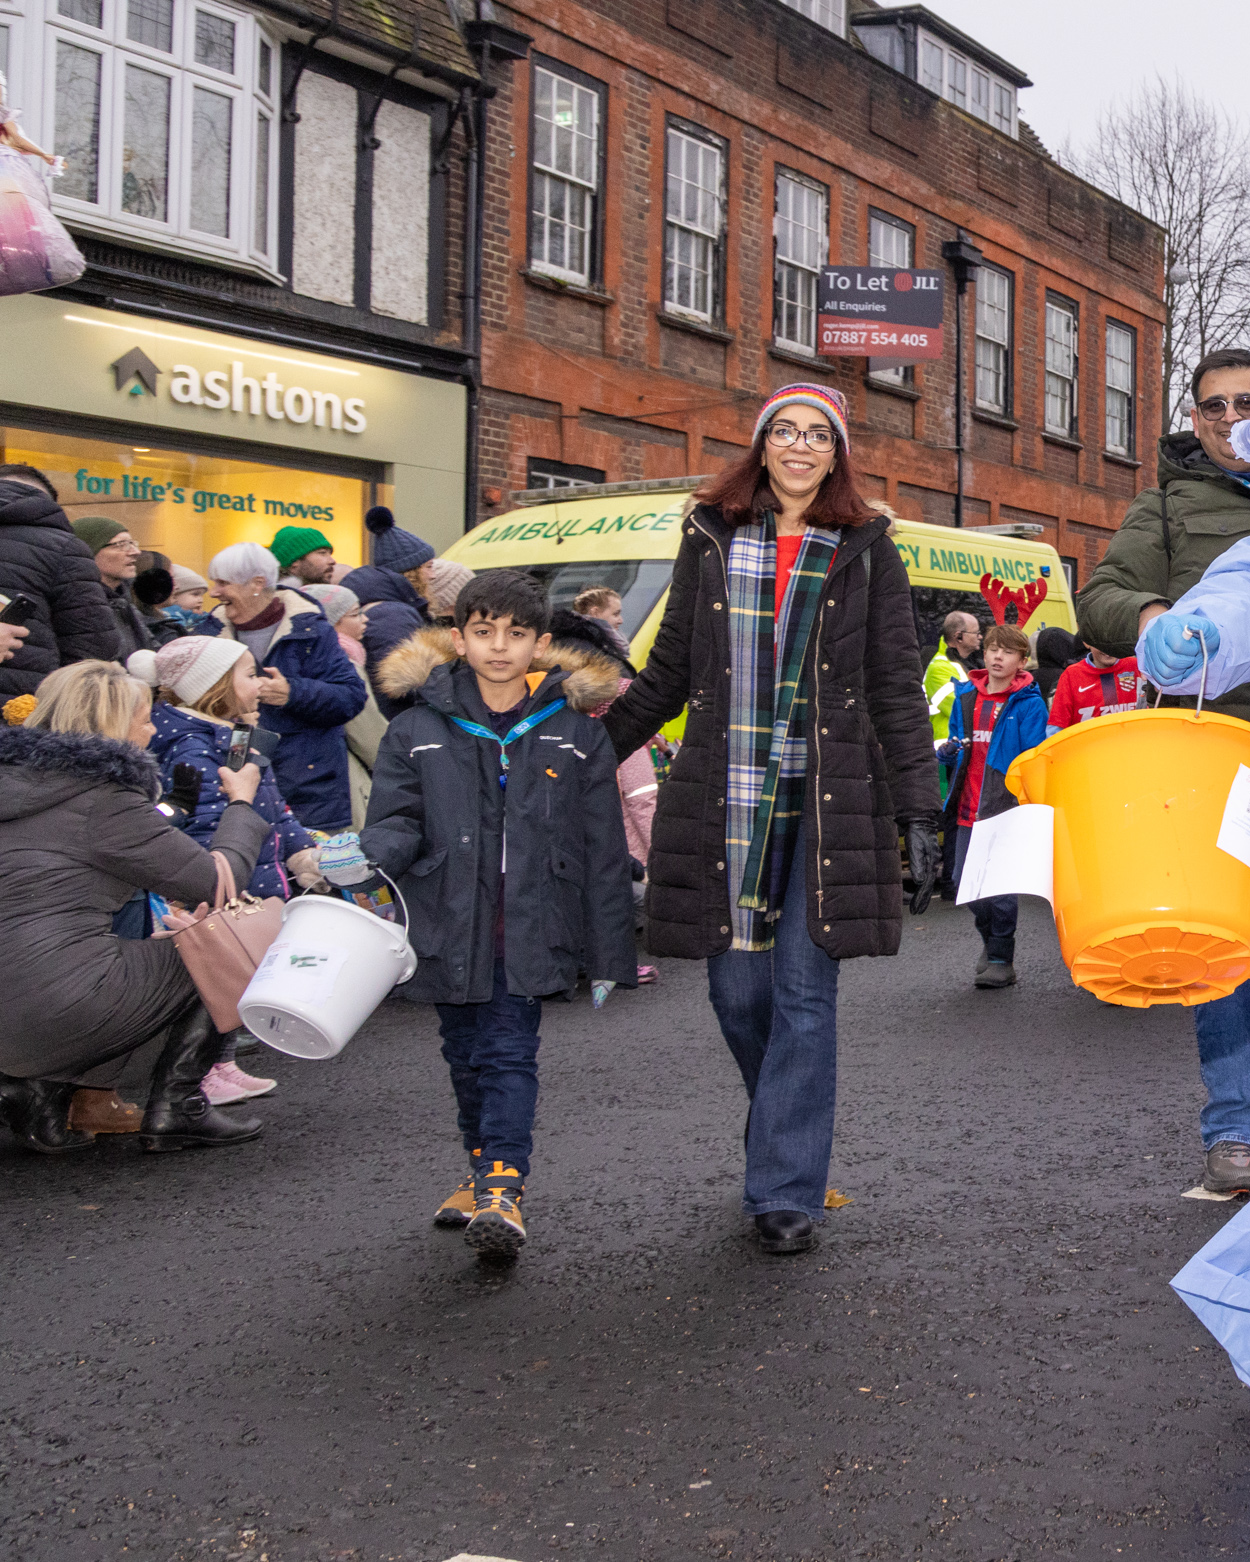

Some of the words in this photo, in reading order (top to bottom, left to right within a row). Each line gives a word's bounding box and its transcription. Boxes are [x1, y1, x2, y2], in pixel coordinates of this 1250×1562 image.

[825, 272, 851, 290] To
[856, 273, 889, 291] Let
[912, 276, 939, 290] JLL
[824, 301, 837, 310] All
[840, 301, 887, 312] Enquiries
[822, 331, 867, 344] 07887
[870, 332, 898, 345] 554
[901, 333, 928, 347] 405
[170, 361, 367, 433] ashtons
[75, 468, 115, 495] for
[122, 473, 185, 504] life's
[193, 489, 256, 513] great
[264, 498, 335, 522] moves
[469, 513, 682, 546] AMBULANCE
[929, 547, 1037, 583] AMBULANCE
